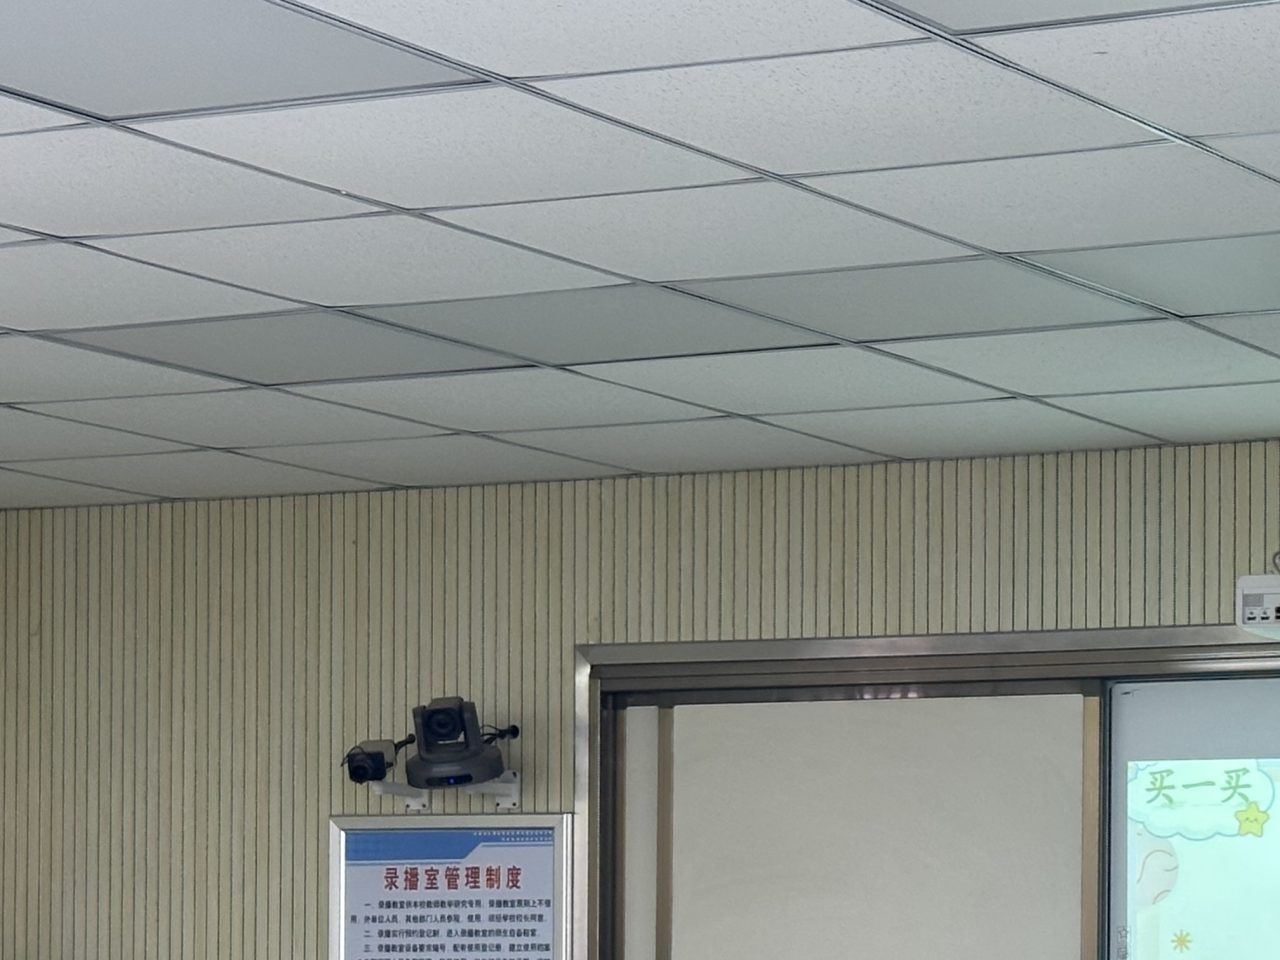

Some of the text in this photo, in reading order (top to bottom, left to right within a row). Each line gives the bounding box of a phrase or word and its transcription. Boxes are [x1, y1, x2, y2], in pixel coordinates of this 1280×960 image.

[1145, 767, 1251, 804] 买一买
[384, 866, 522, 891] 录播室管理制度
